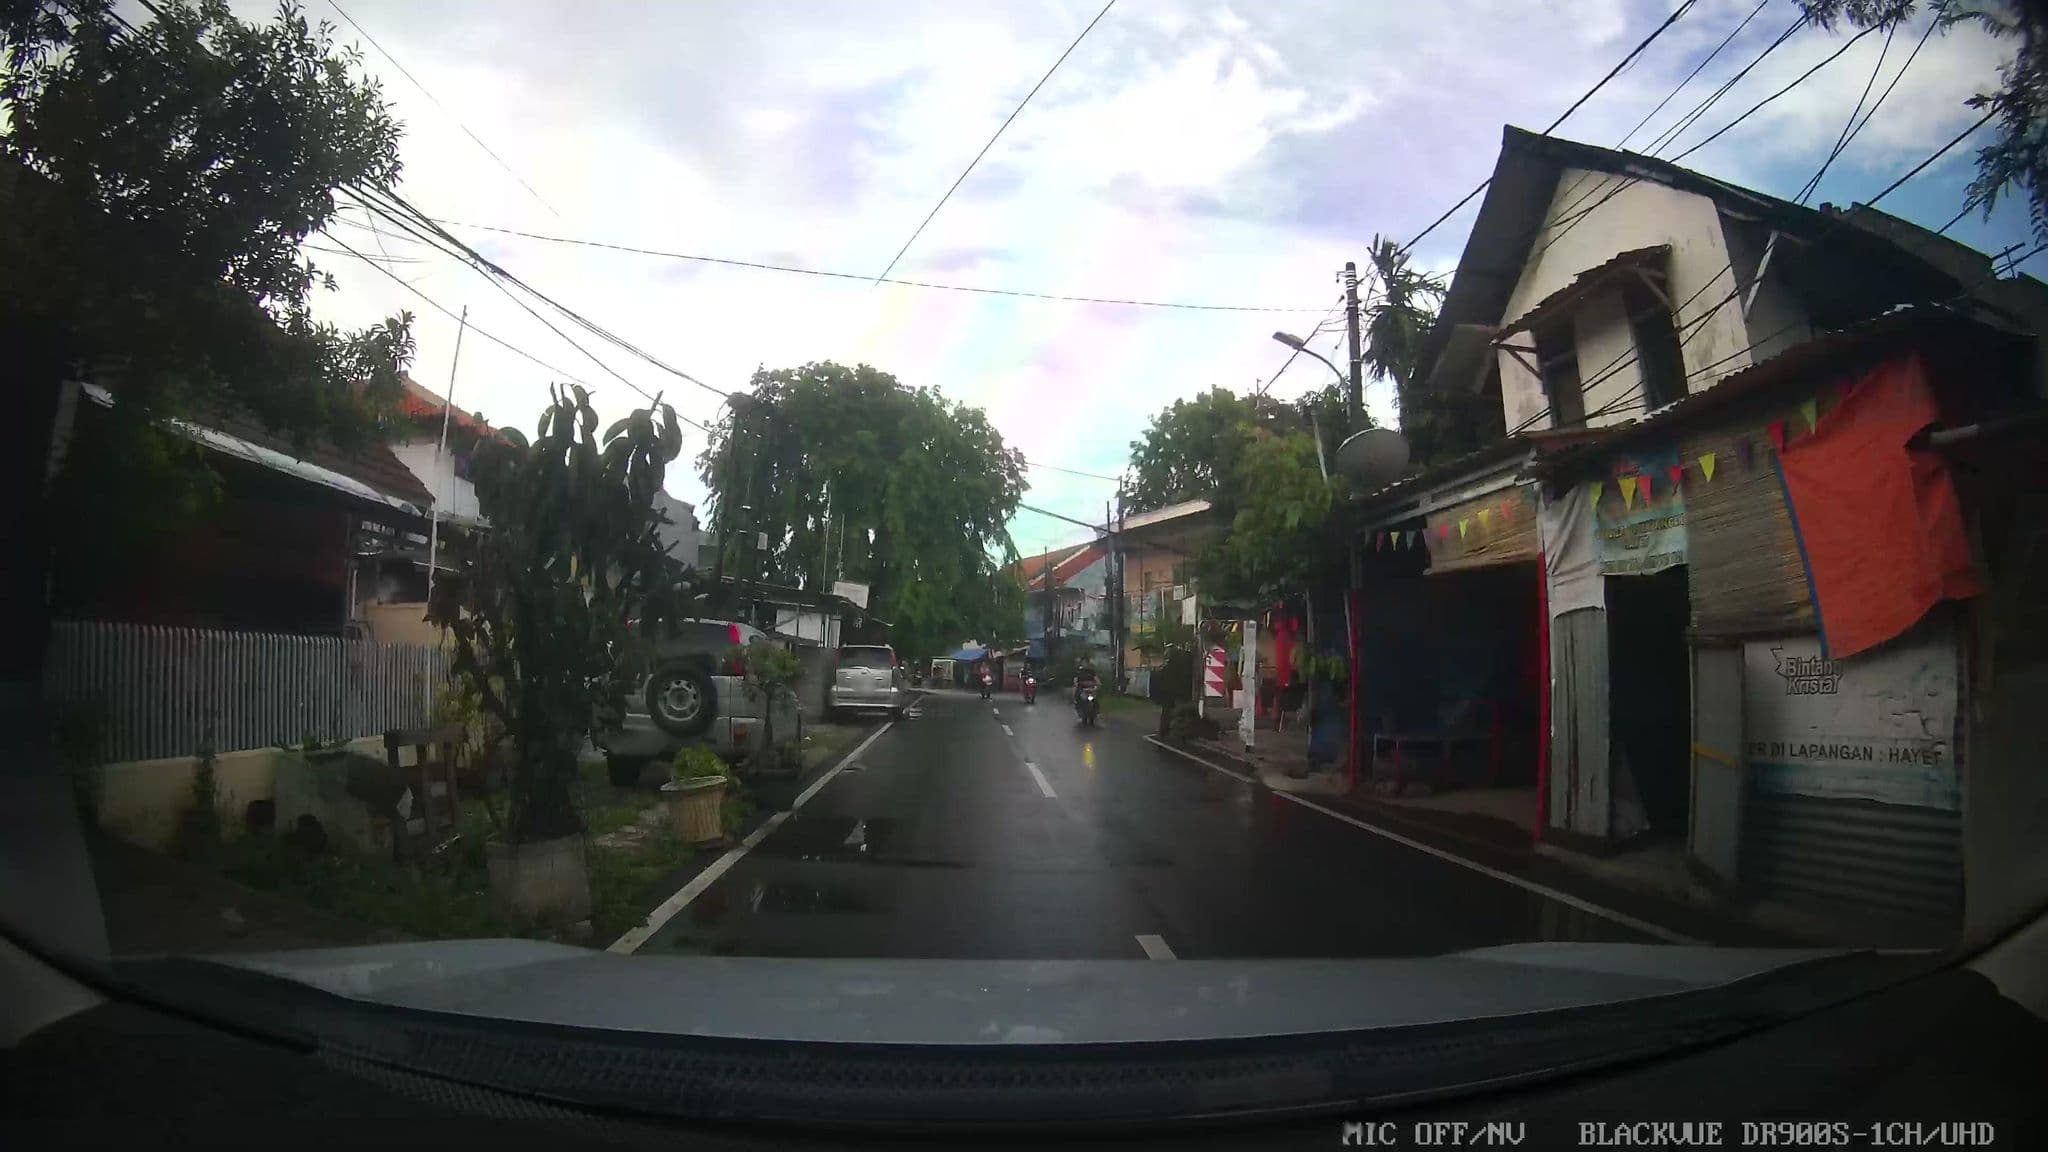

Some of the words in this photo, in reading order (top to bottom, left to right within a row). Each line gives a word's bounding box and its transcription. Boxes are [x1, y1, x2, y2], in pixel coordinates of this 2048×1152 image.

[1786, 676, 1841, 695] Kristal
[1770, 742, 1785, 758] DI
[1789, 743, 1873, 762] LAPANGAN
